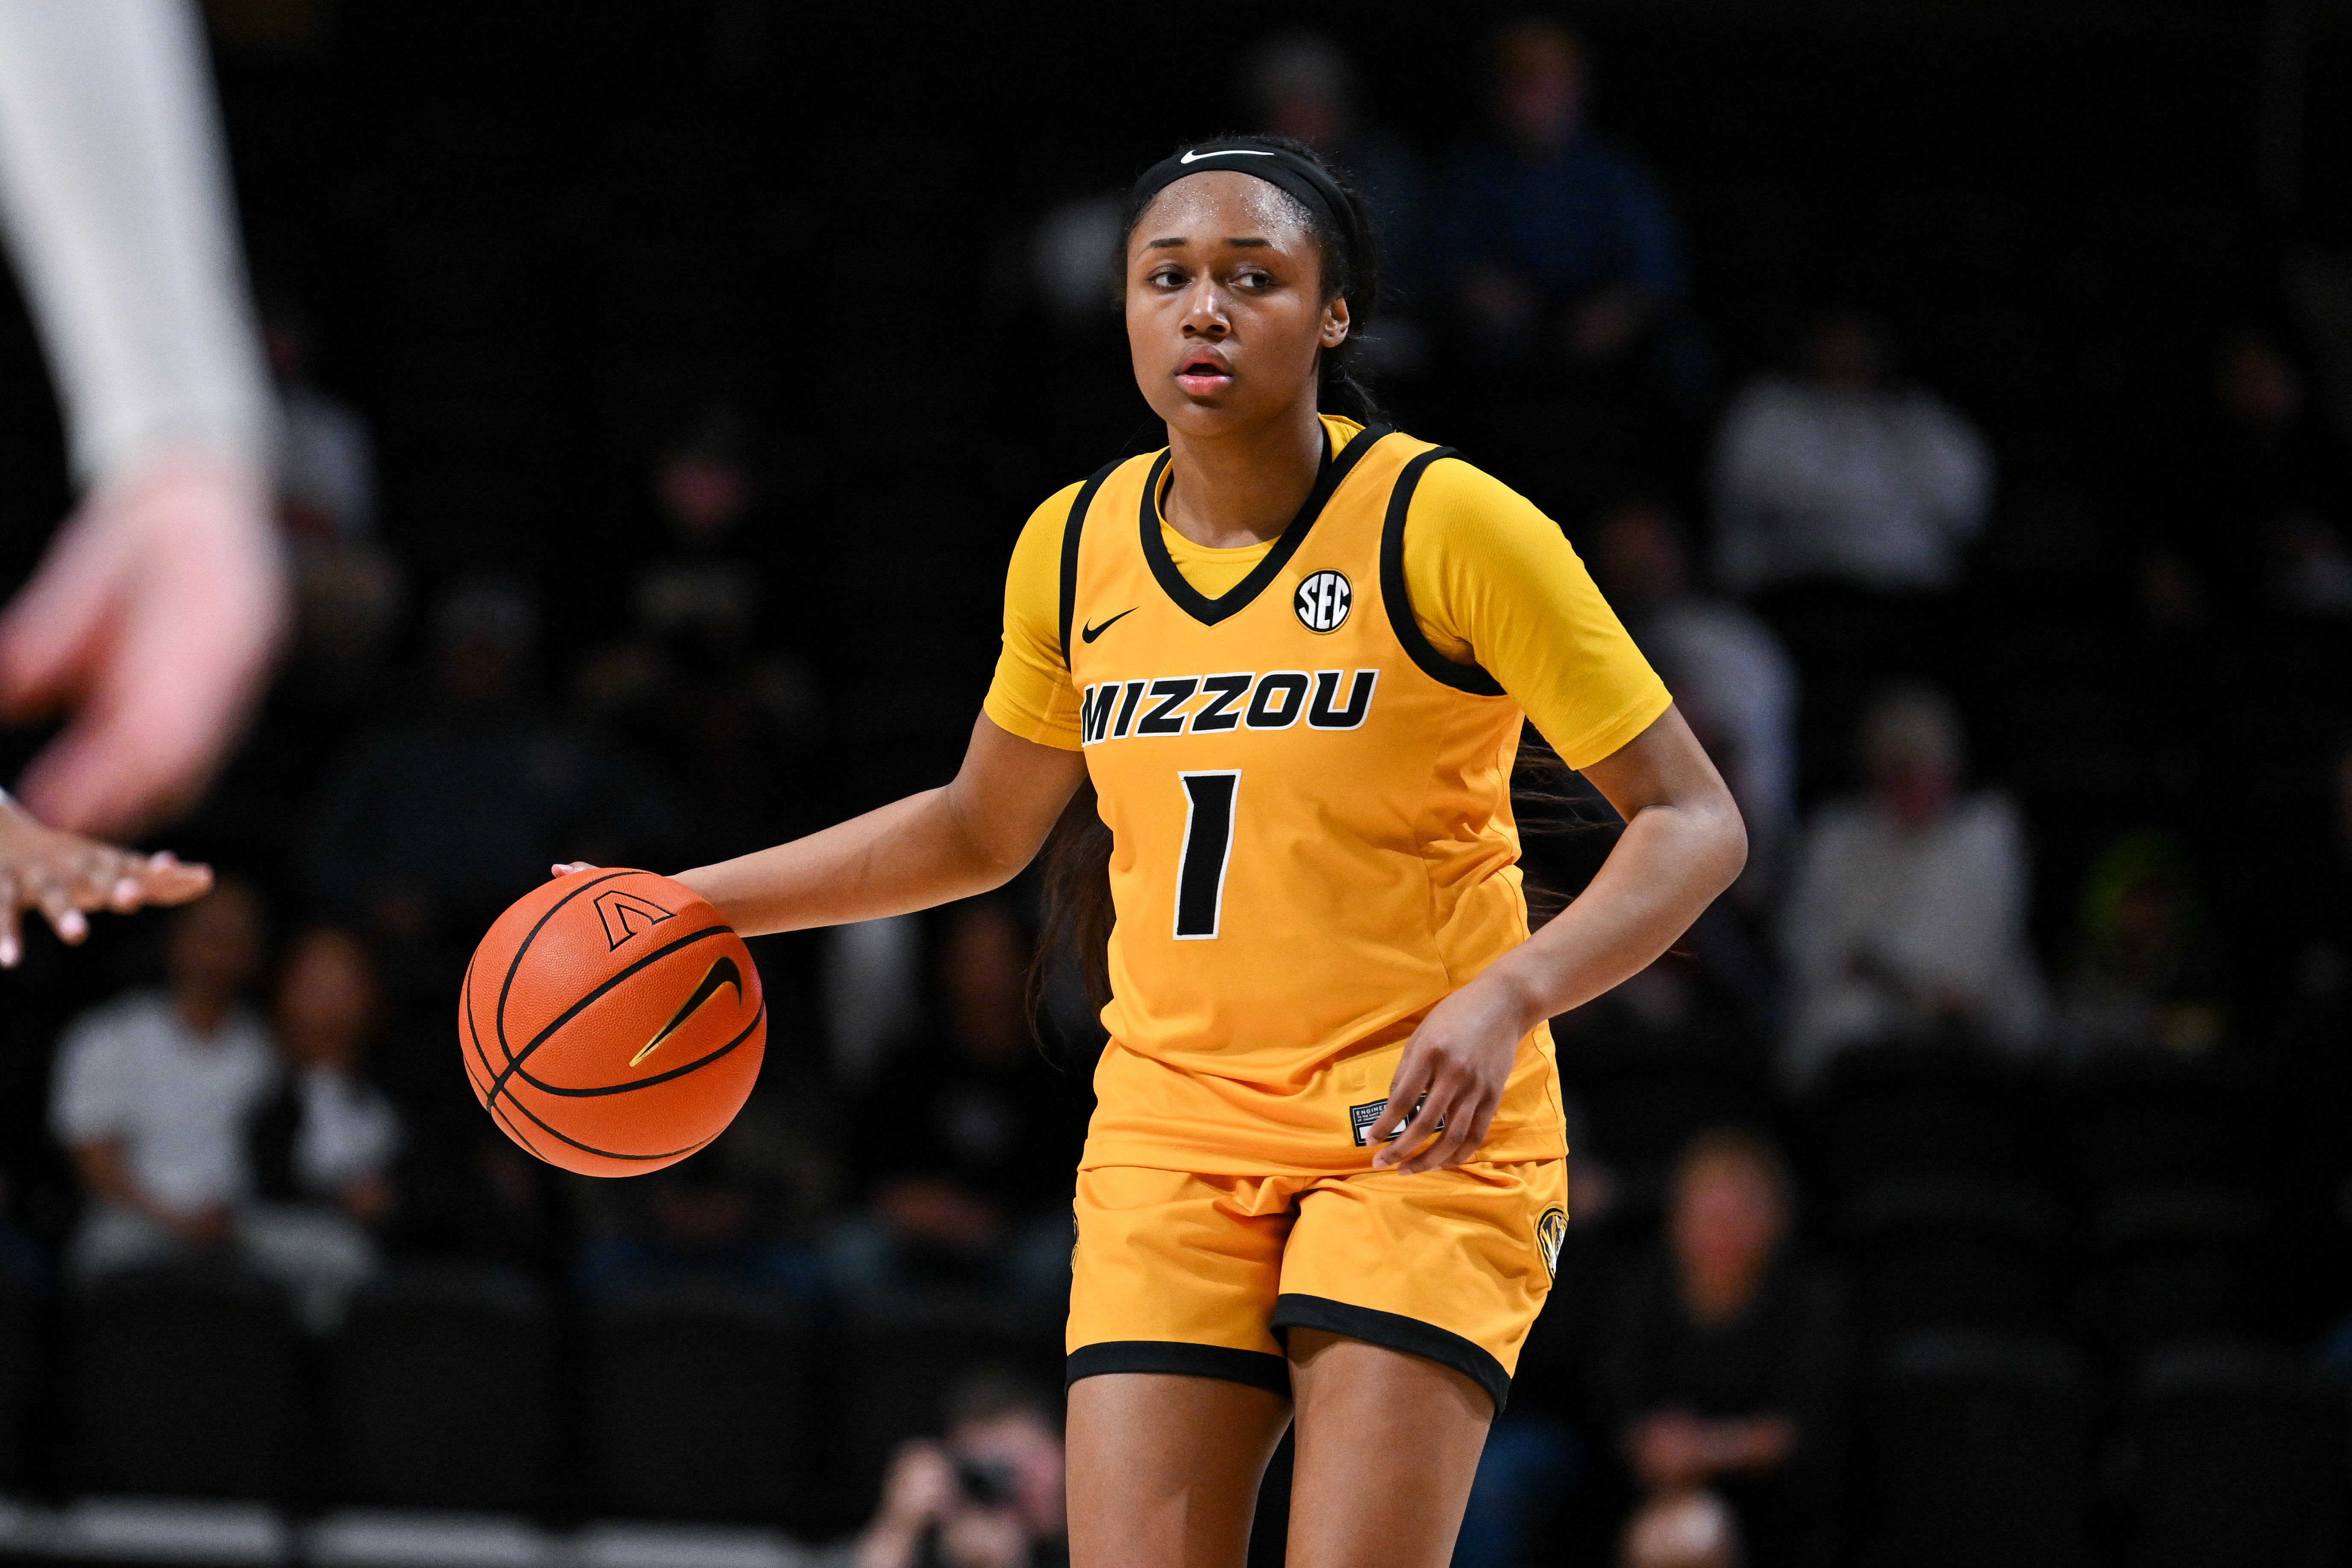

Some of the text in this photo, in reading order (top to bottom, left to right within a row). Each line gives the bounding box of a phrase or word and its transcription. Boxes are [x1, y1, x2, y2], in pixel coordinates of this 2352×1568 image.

[1298, 573, 1349, 630] SEC
[1081, 668, 1381, 748] MIZZOU
[1173, 769, 1243, 941] 1
